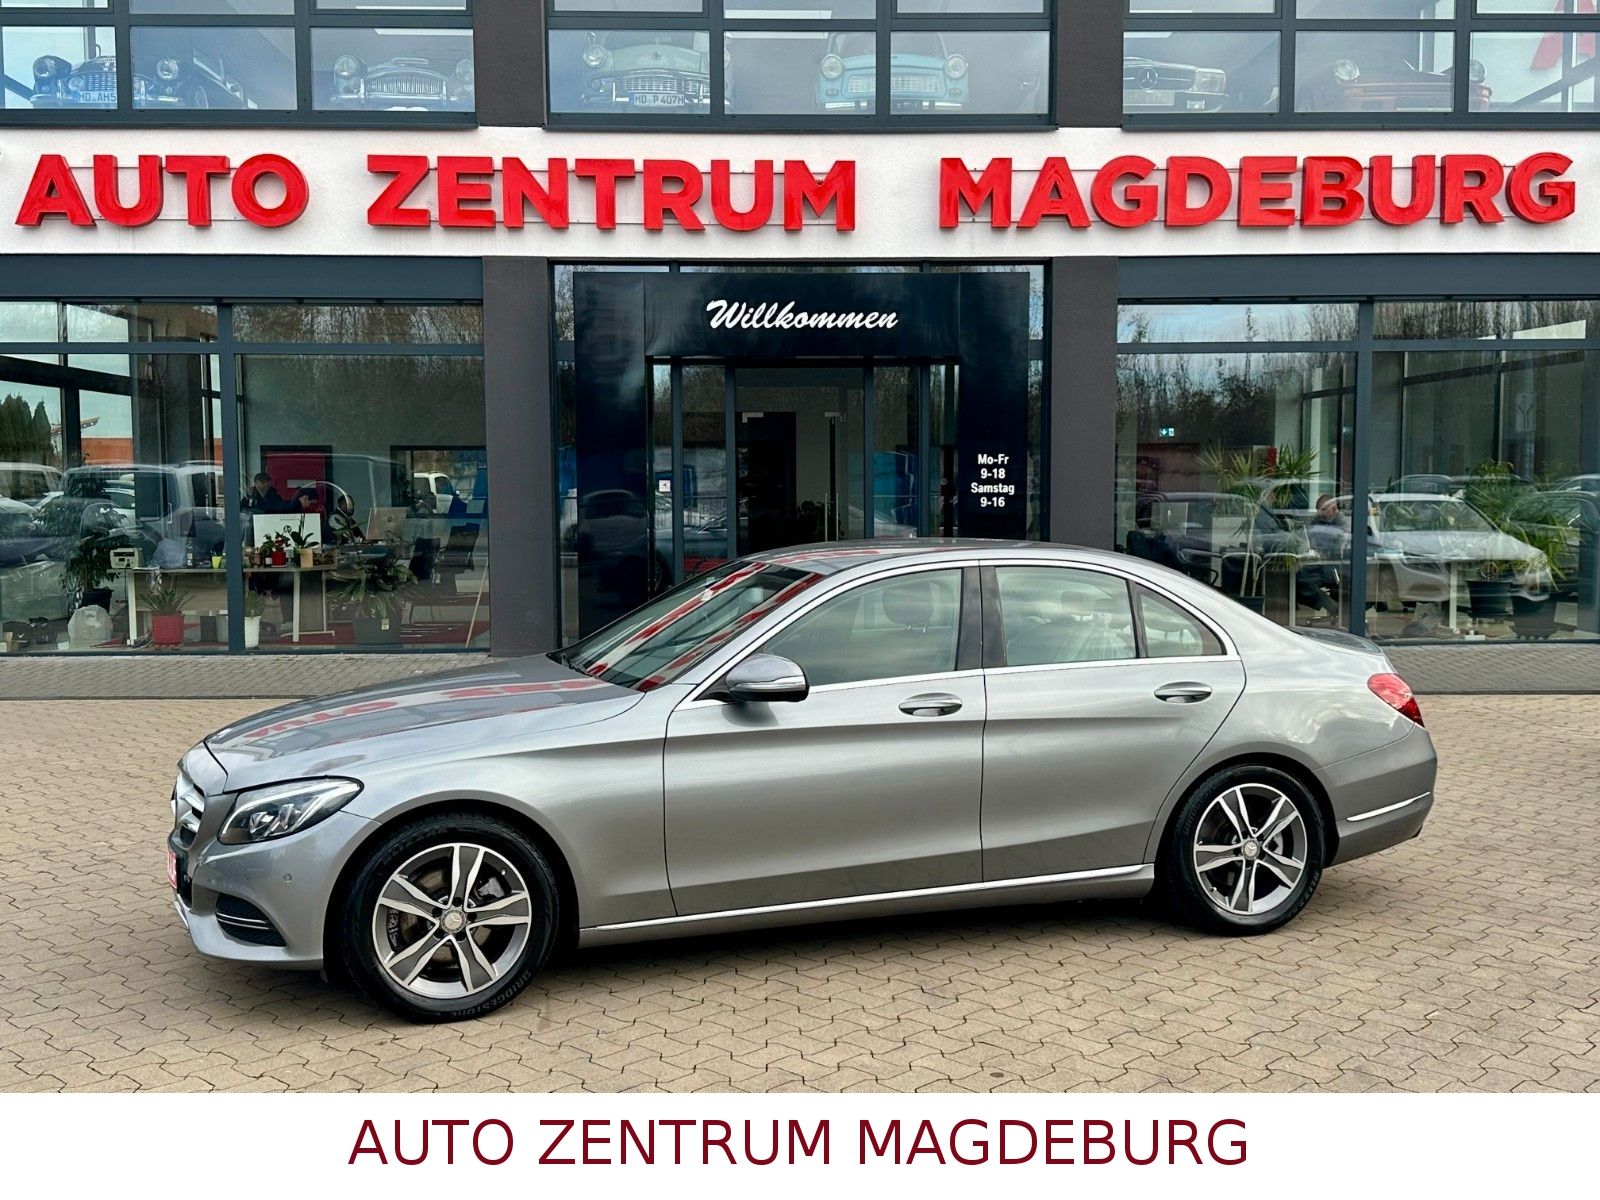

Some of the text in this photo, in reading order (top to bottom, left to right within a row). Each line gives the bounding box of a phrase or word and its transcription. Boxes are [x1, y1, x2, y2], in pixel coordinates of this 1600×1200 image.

[15, 152, 1576, 233] AUTO ZENTRUM MAGDEBURG
[706, 299, 899, 329] Willkommen
[977, 453, 1010, 465] Mo-Fr
[980, 468, 1006, 479] 9-18
[970, 482, 1015, 496] Samstag
[980, 496, 1006, 508] 9-16
